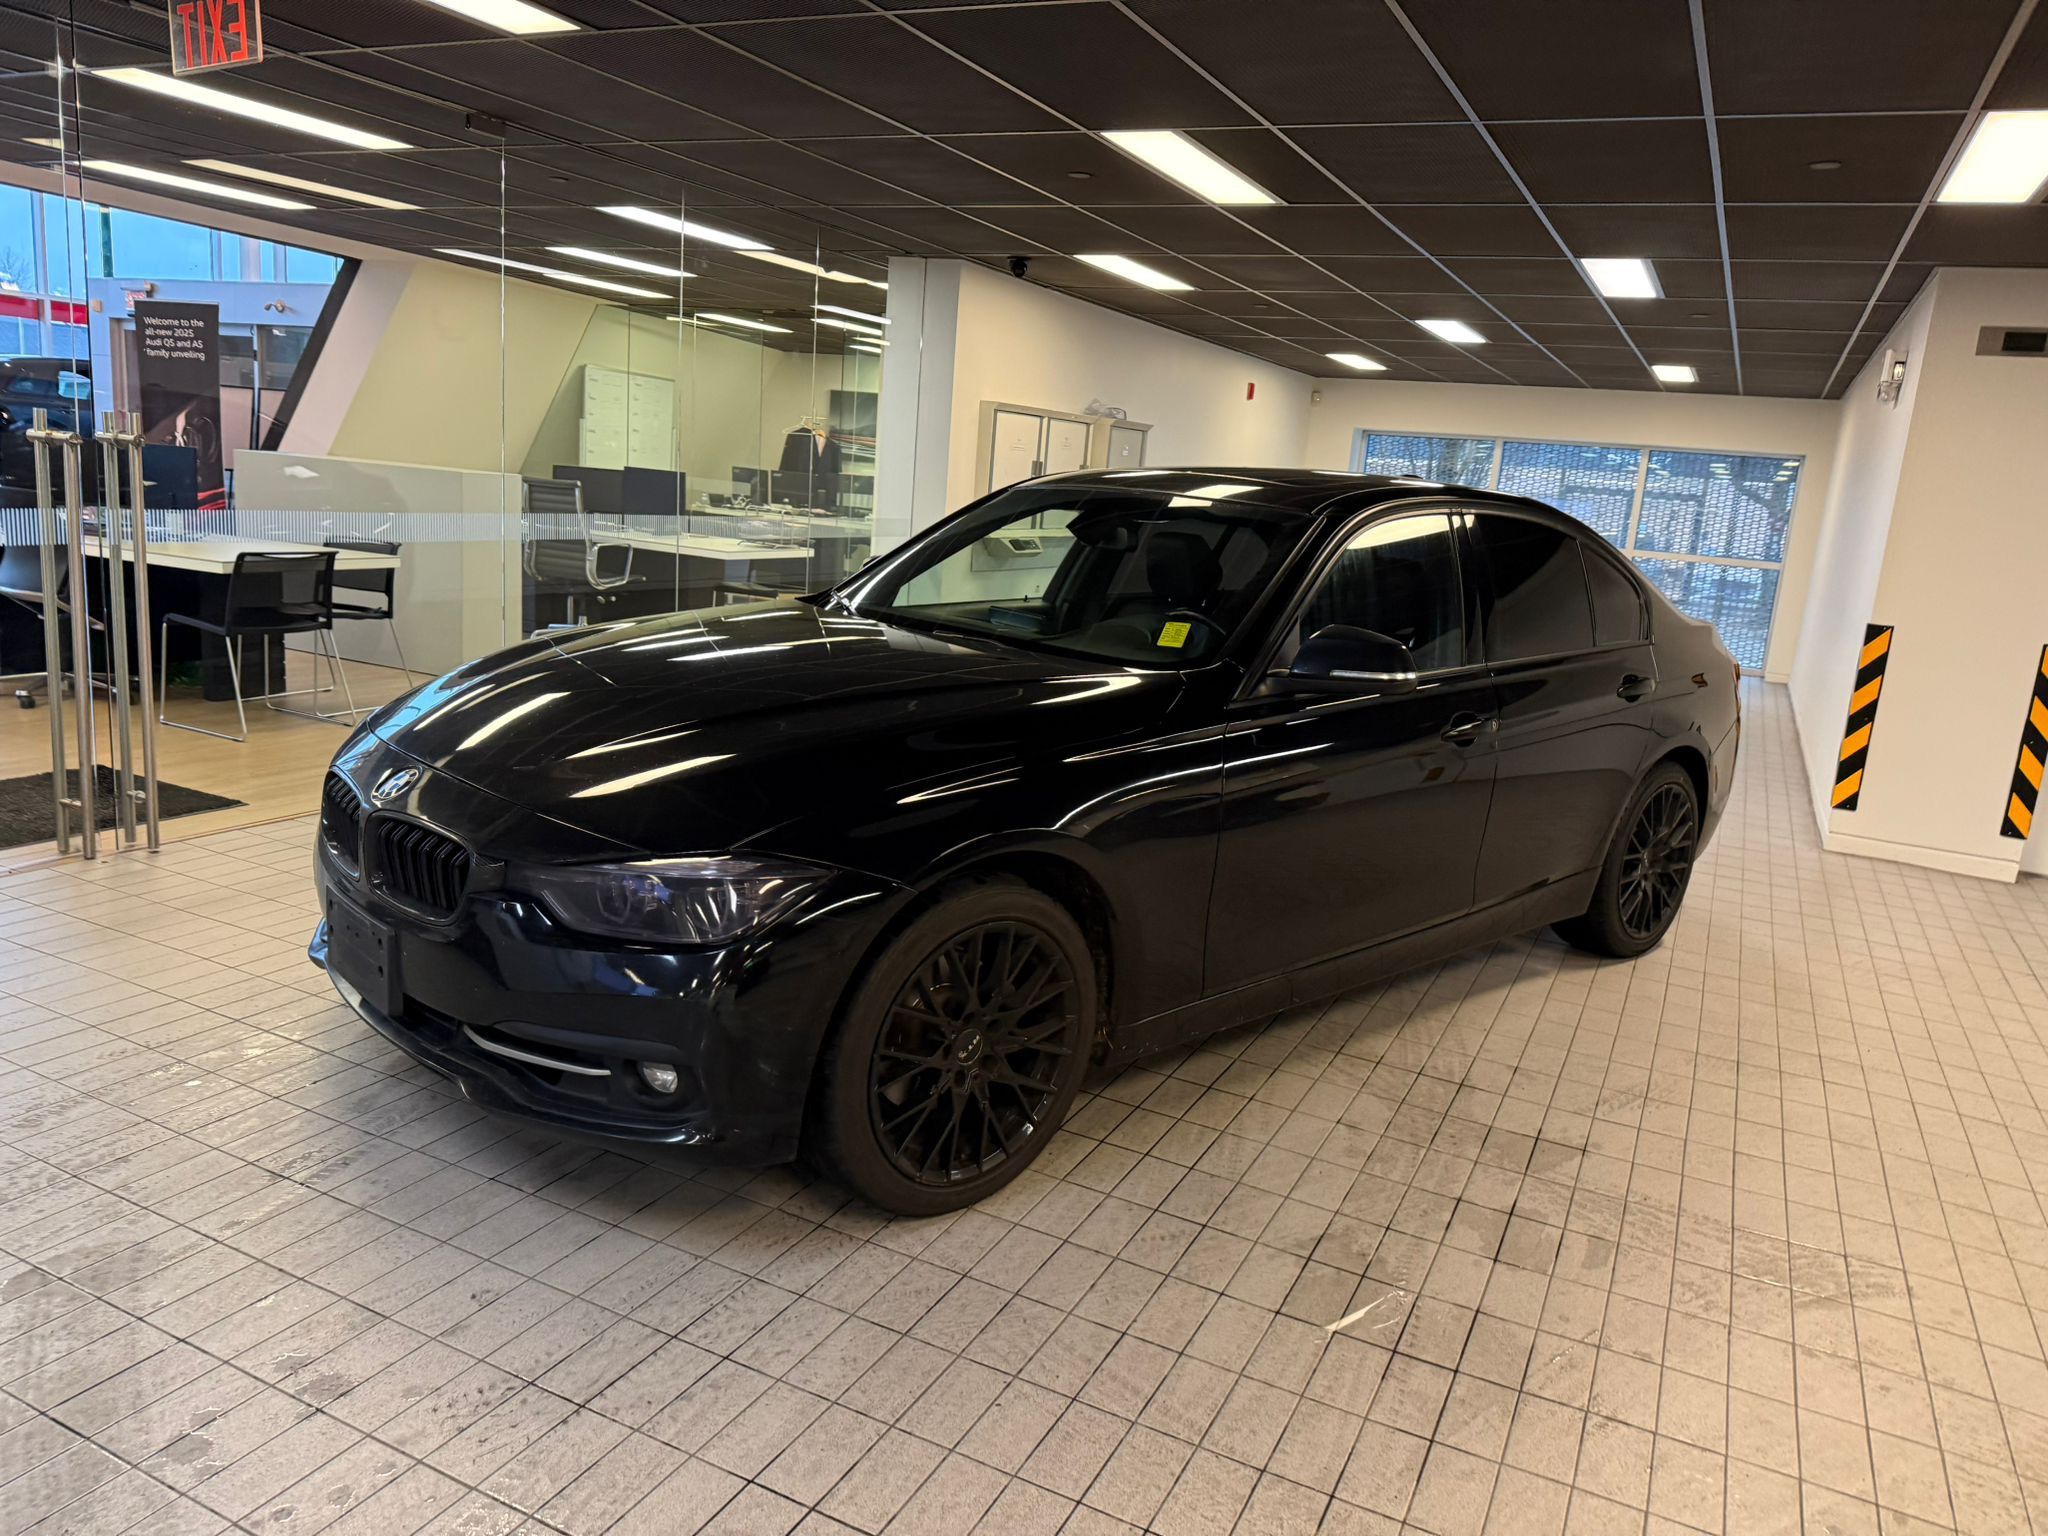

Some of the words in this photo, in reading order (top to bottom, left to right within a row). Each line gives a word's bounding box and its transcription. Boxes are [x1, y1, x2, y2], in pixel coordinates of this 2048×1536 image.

[143, 316, 179, 326] Welcome
[180, 319, 190, 327] to
[190, 318, 204, 328] the
[144, 327, 173, 336] all-new
[173, 328, 195, 337] 2025
[145, 337, 162, 346] Audi
[163, 338, 175, 347] Q5
[176, 339, 191, 348] and
[192, 340, 204, 348] A5
[147, 348, 169, 359] family
[171, 350, 205, 361] unveiling
